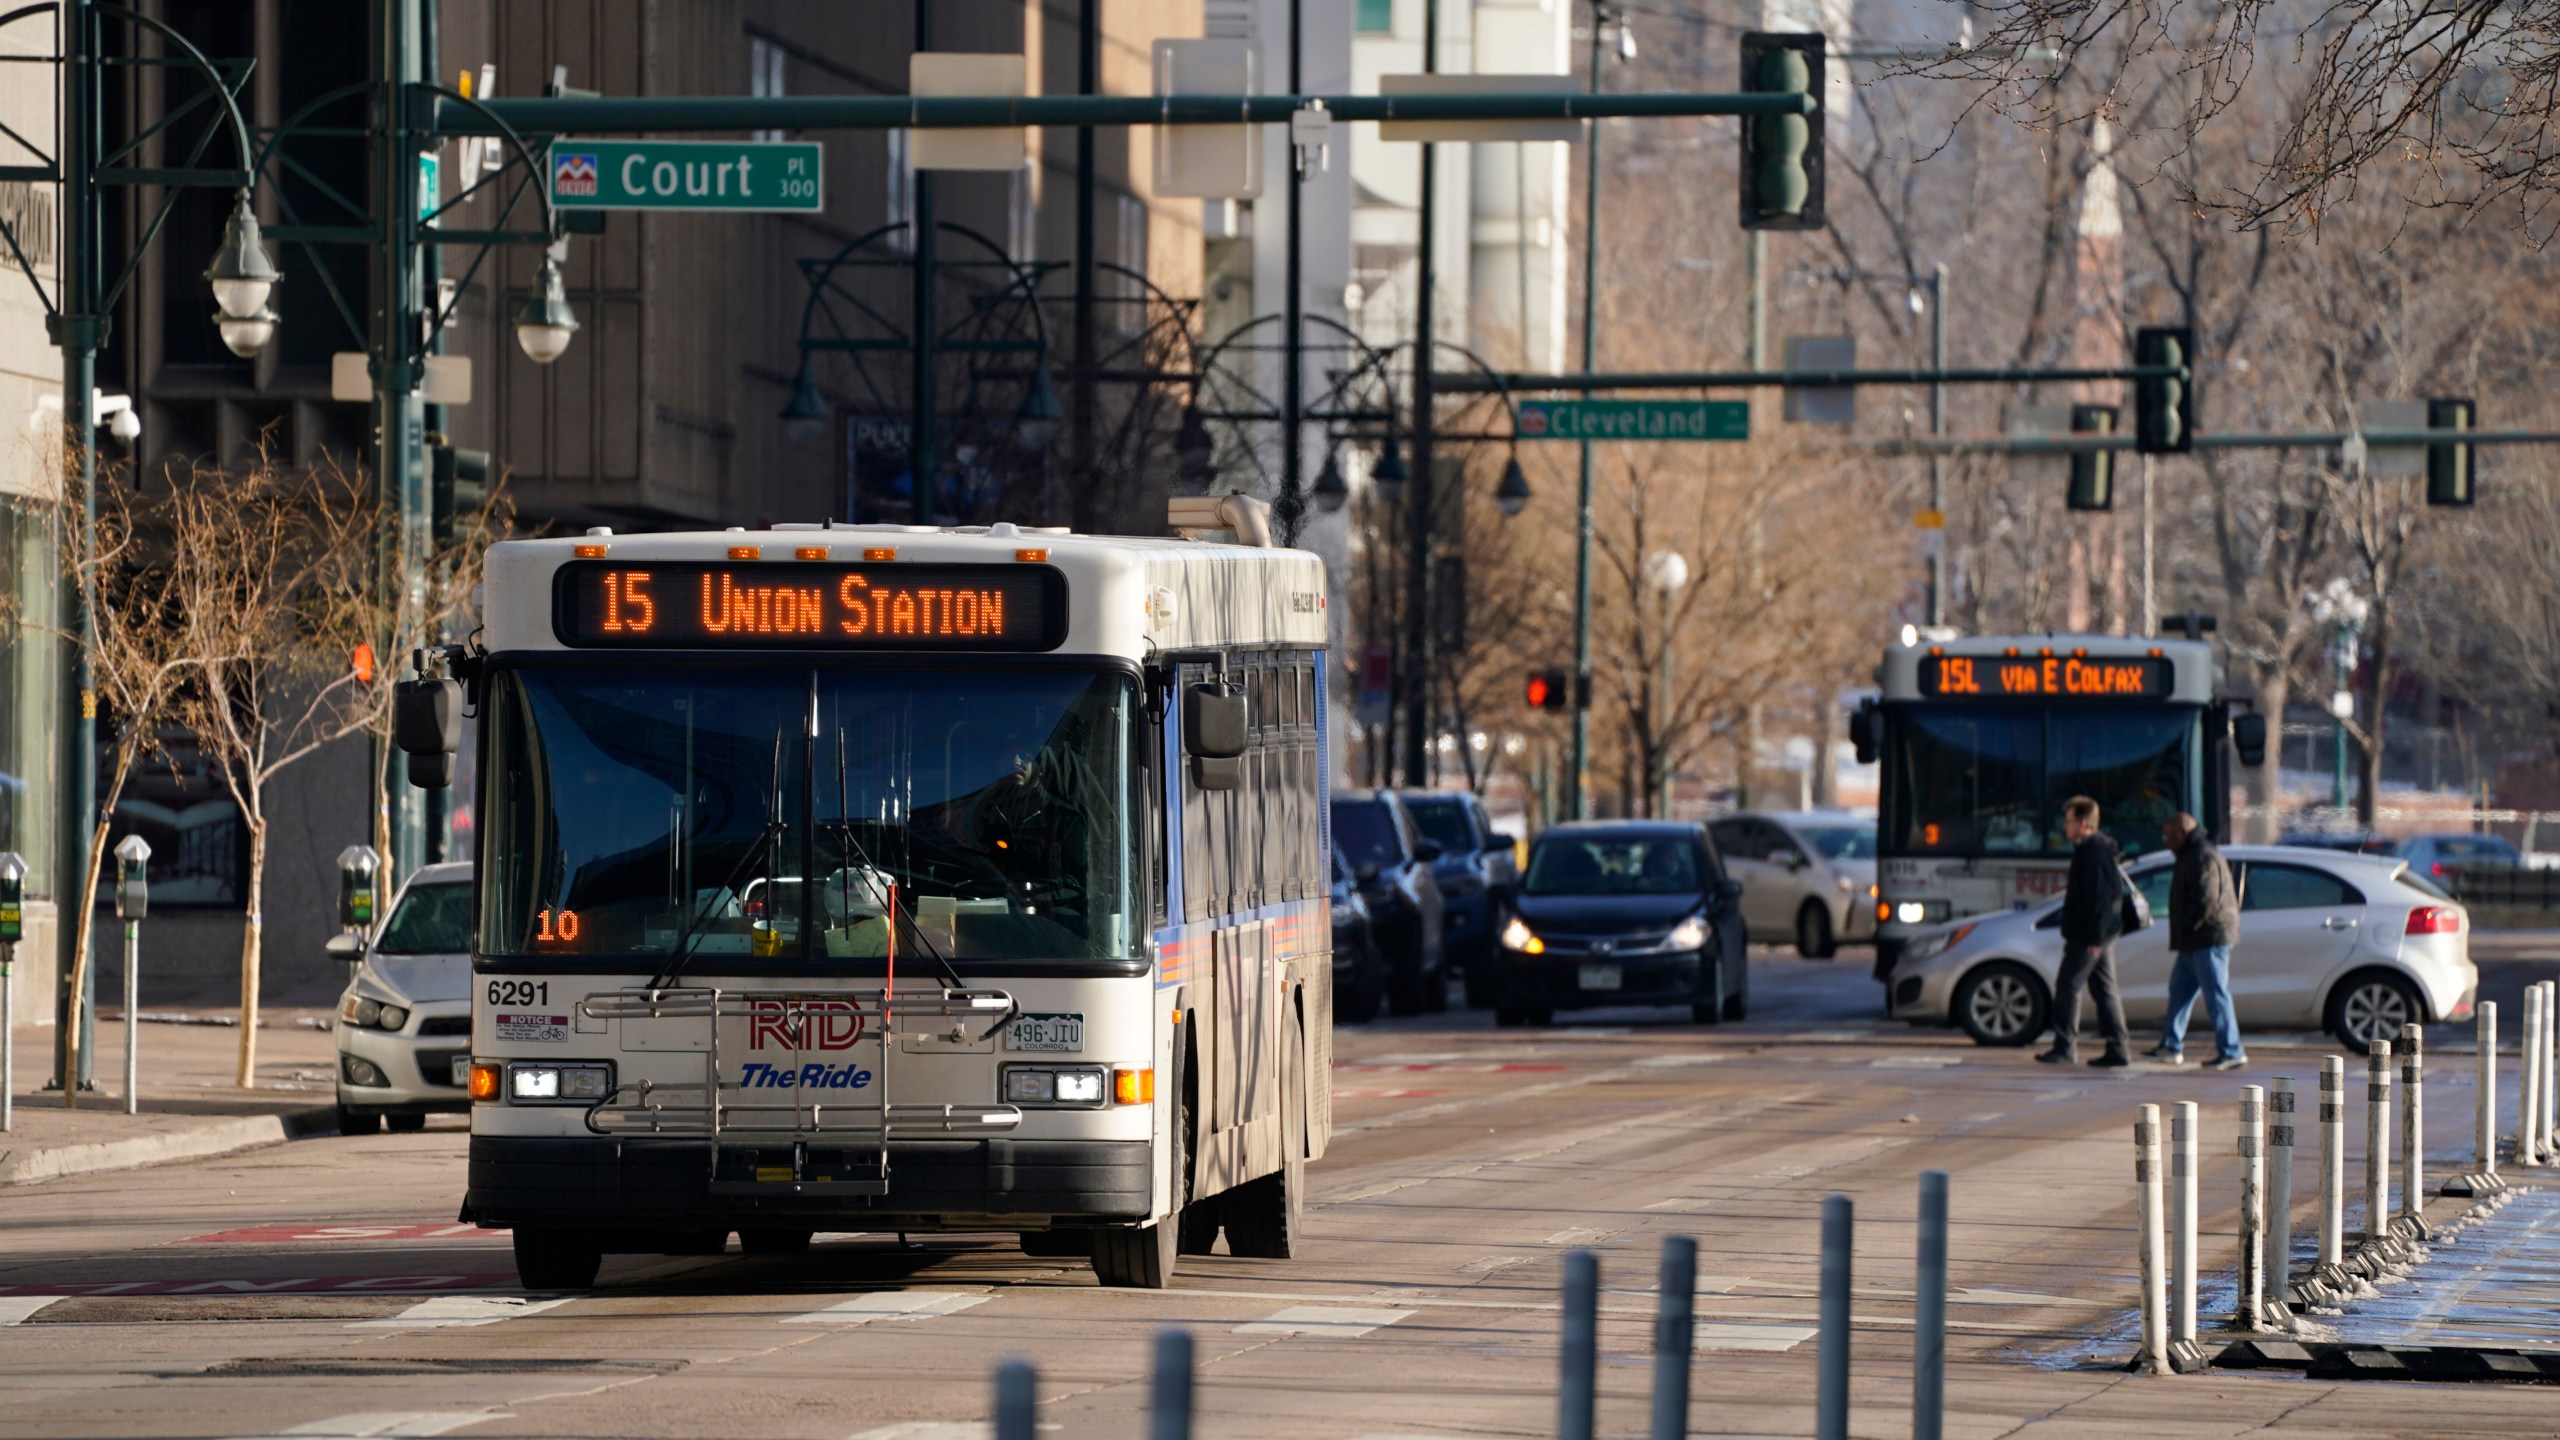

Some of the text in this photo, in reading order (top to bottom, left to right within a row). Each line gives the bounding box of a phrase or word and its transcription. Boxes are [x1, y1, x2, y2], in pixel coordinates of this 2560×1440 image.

[621, 153, 752, 197] Court
[787, 158, 805, 176] Pl
[779, 179, 815, 197] 300
[1551, 406, 1706, 436] Cleveland
[603, 573, 1002, 635] 15 UNION STATION
[1939, 658, 2143, 694] 15L VIA E COLFAX
[537, 910, 578, 940] 10
[488, 980, 548, 1007] 6291
[510, 1015, 552, 1024] NOTICE
[750, 999, 865, 1050] RTD
